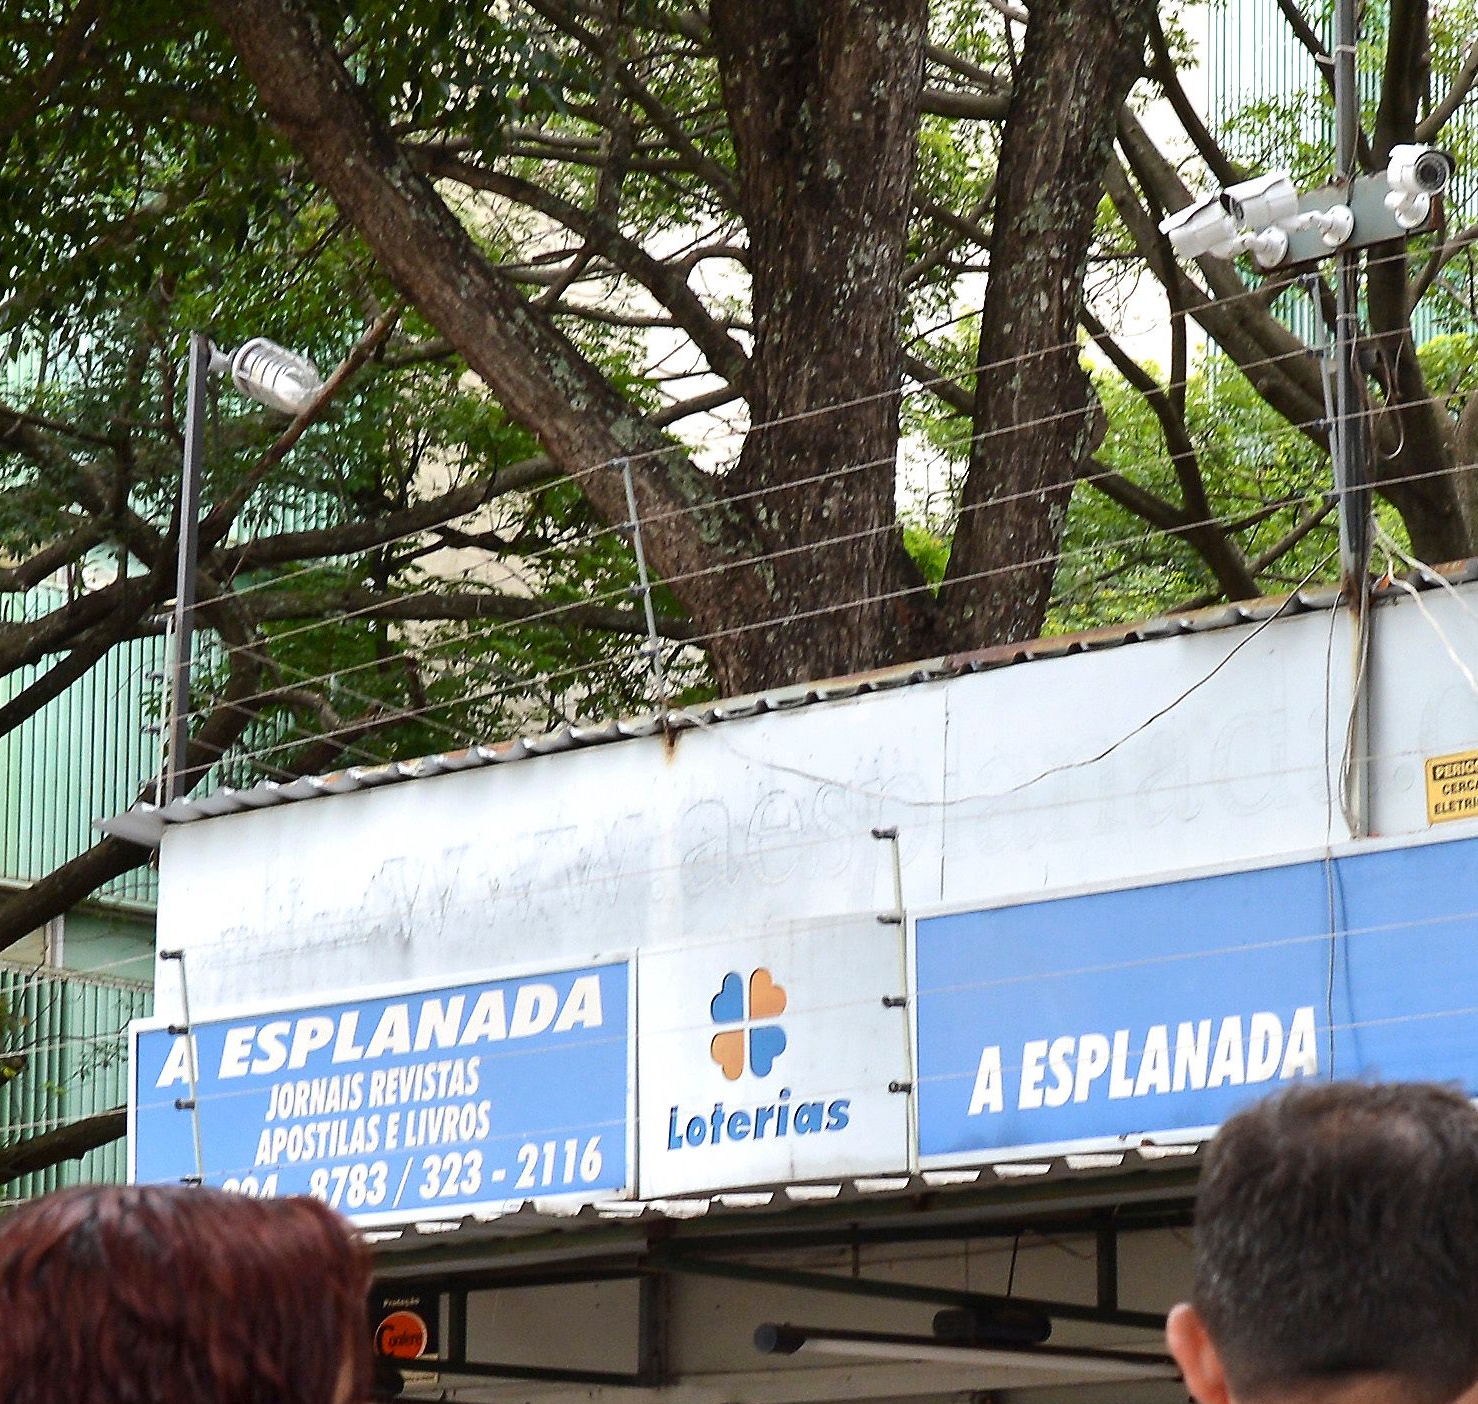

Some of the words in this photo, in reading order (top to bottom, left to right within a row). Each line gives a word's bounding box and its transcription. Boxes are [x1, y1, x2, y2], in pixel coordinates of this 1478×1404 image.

[156, 1036, 198, 1088] A
[217, 974, 603, 1080] ESPLANADA
[968, 1045, 1002, 1117] A
[1017, 1005, 1319, 1111] ESPLANADA
[264, 1071, 364, 1122] JORNAIS
[368, 1056, 481, 1108] REVISTAS
[668, 1087, 851, 1151] Loterias
[254, 1114, 382, 1167] APOSTILAS
[385, 1118, 402, 1151] E
[404, 1099, 491, 1147] LIVROS
[308, 1158, 389, 1212] 8783
[419, 1148, 484, 1201] 323
[515, 1136, 602, 1191] 2116
